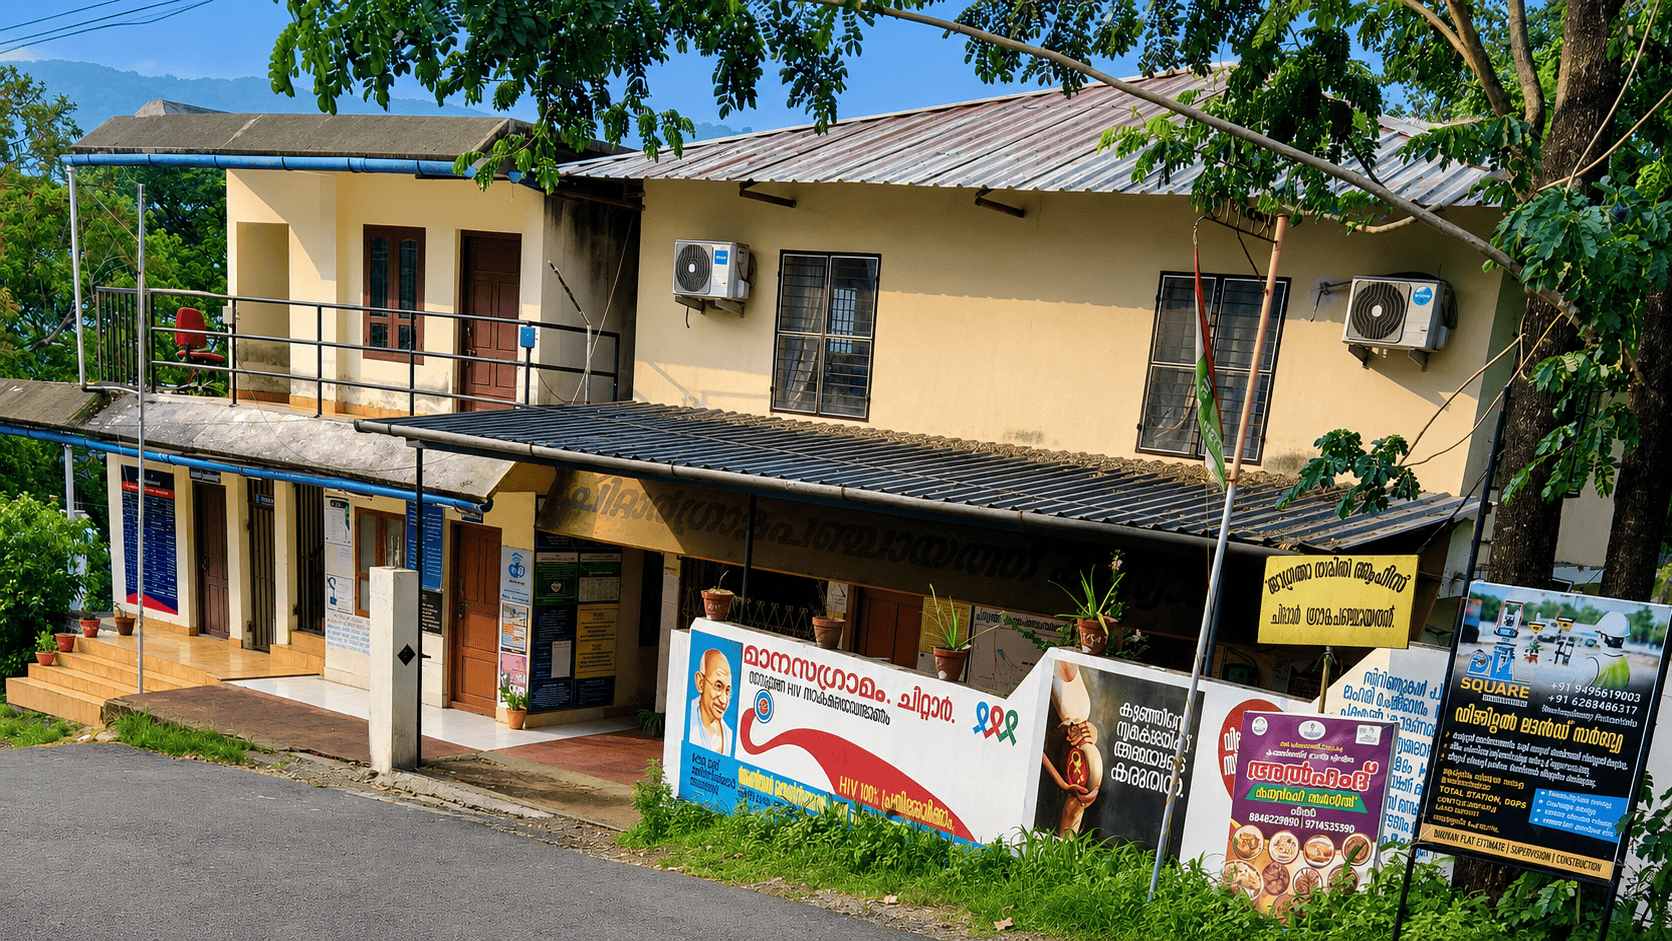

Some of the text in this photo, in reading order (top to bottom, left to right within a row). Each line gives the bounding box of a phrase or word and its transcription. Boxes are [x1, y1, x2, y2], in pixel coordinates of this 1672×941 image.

[787, 682, 802, 698] HIV
[1460, 677, 1531, 699] SQUARE
[1551, 681, 1571, 692] +91
[897, 686, 956, 724] ചിറ്റാർ.
[1548, 694, 1568, 704] +91
[839, 775, 859, 796] HIV
[860, 782, 880, 806] 100%
[1439, 785, 1465, 797] TOTAL
[1466, 790, 1502, 805] STATION,
[1459, 834, 1476, 845] FLAT
